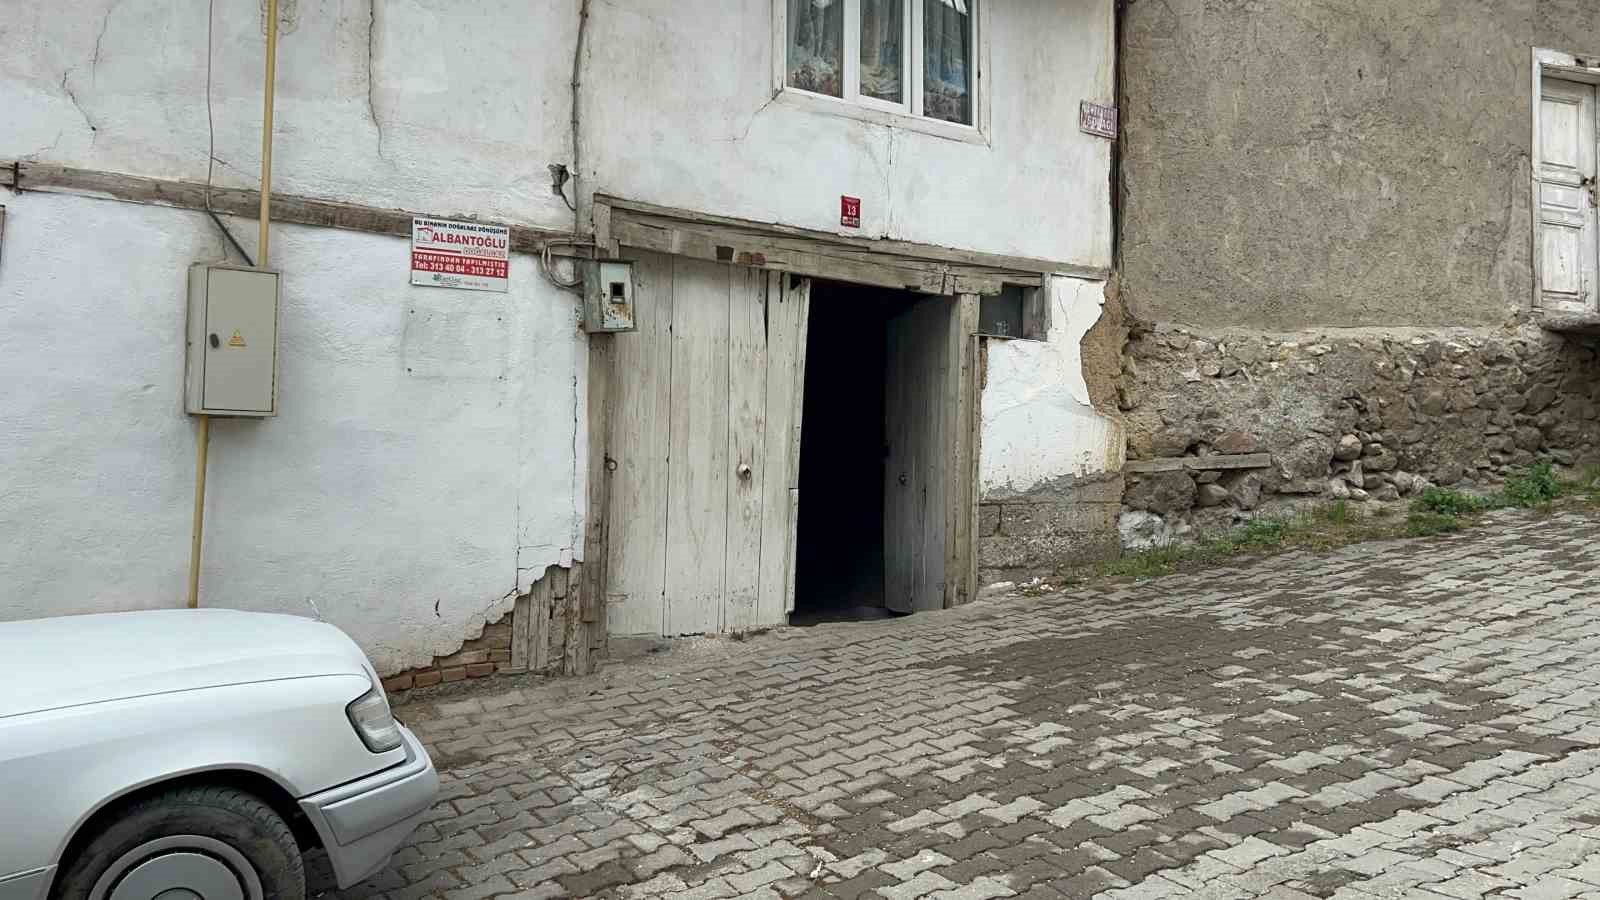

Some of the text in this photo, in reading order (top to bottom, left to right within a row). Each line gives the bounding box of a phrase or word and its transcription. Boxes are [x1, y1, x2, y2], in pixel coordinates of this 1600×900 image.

[432, 231, 506, 249] ALBANTOĞLU
[430, 262, 444, 271] 313
[445, 264, 455, 272] 40
[471, 266, 484, 274] 313
[496, 269, 505, 277] 12
